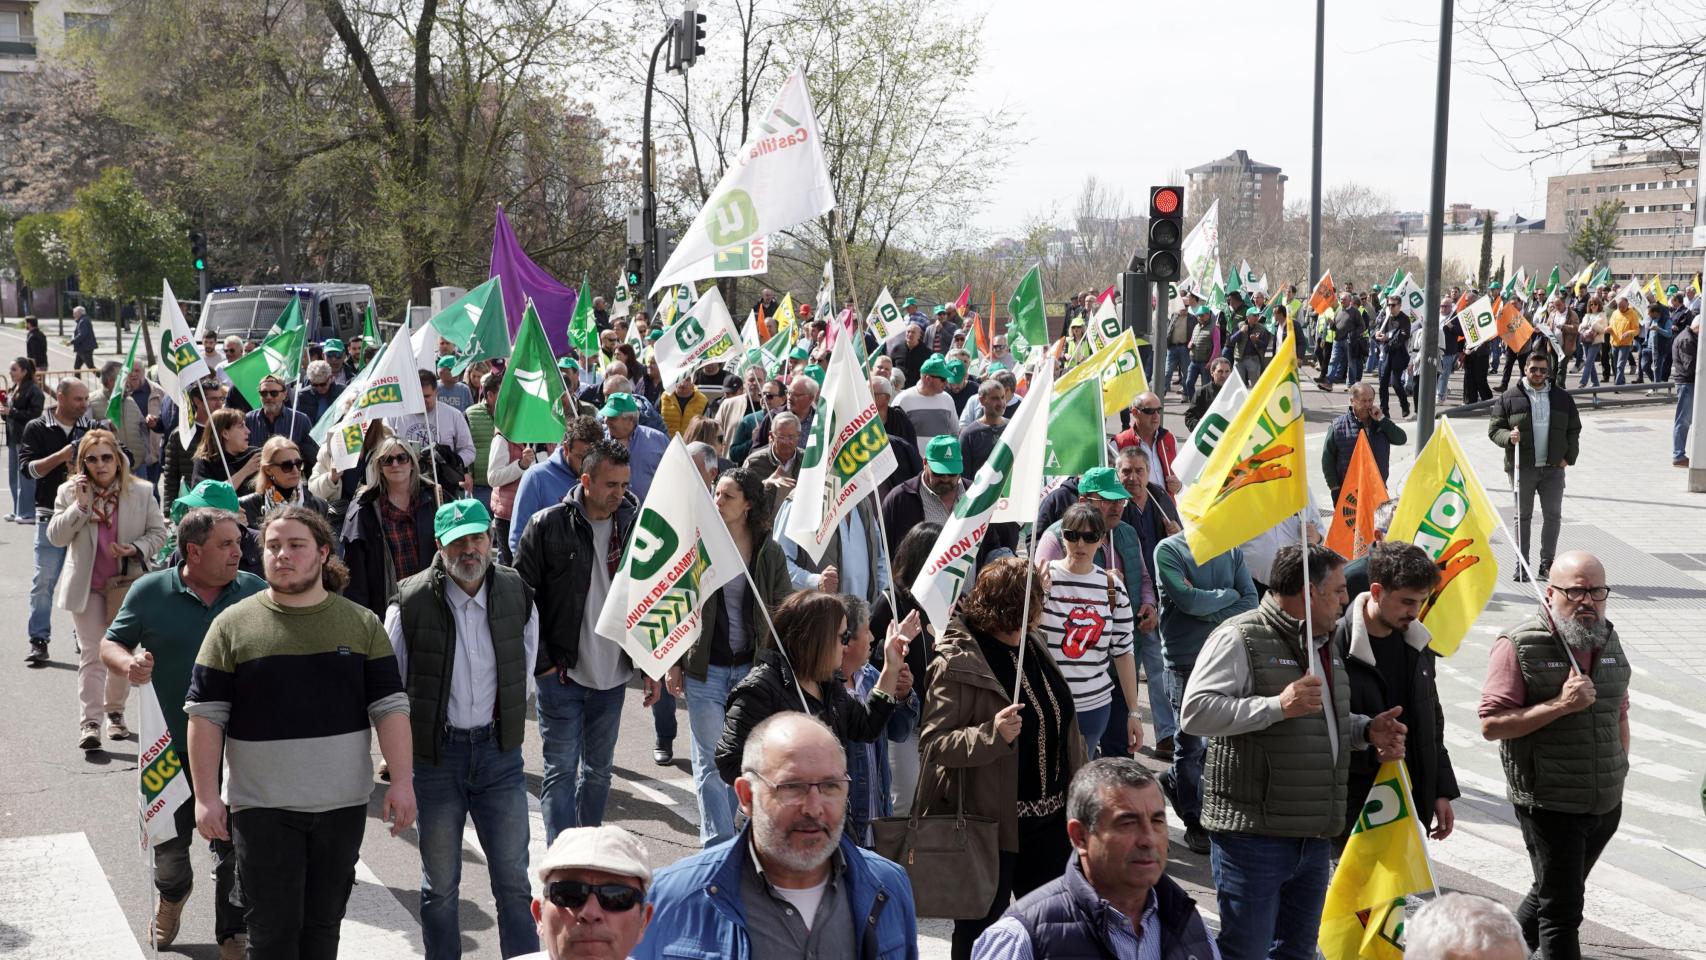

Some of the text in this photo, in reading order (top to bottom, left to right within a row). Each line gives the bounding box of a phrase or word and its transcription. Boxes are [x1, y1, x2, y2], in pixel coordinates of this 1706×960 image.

[838, 423, 890, 475] UCCL
[927, 522, 987, 576] UNION DE
[626, 593, 654, 630] UNION
[651, 579, 671, 602] DE
[653, 624, 691, 661] Castilla
